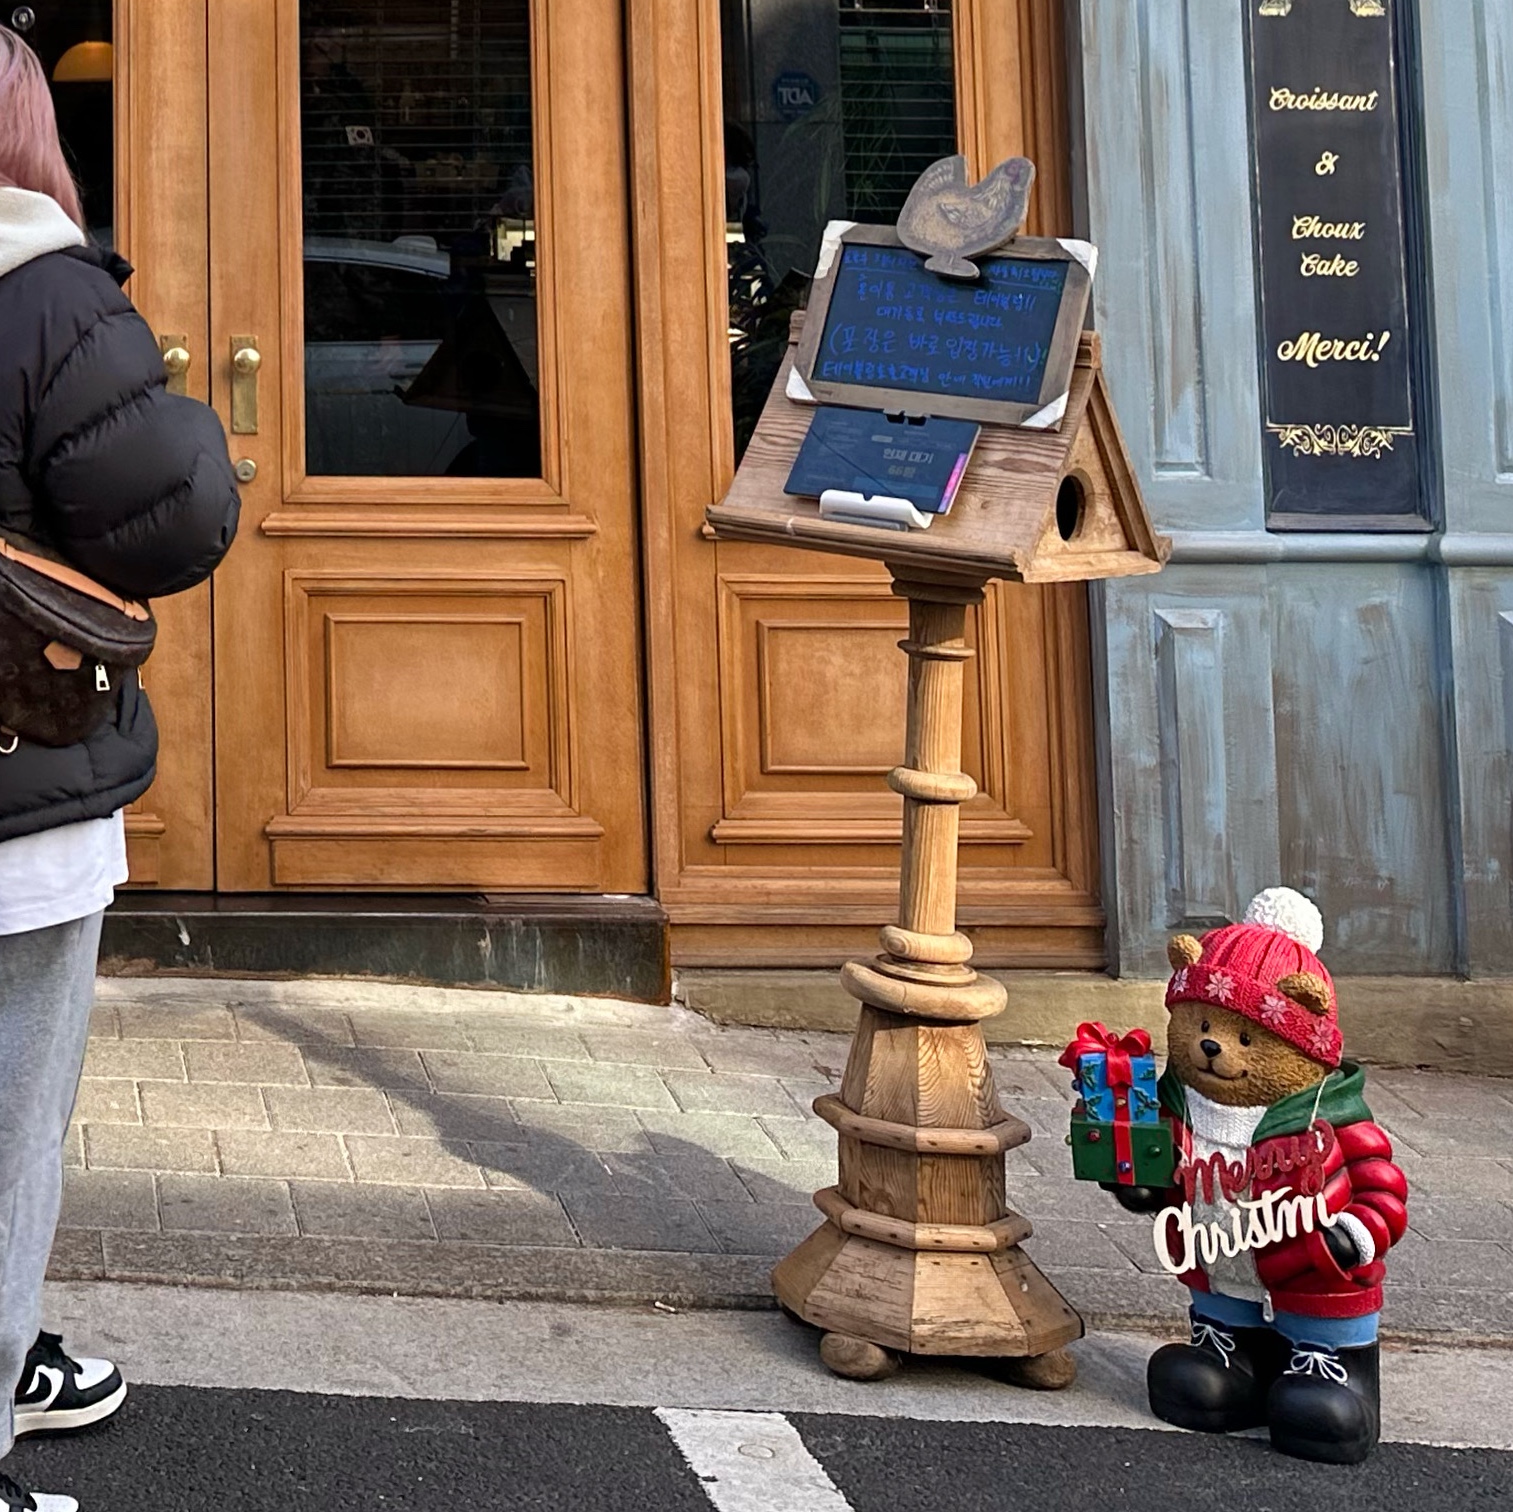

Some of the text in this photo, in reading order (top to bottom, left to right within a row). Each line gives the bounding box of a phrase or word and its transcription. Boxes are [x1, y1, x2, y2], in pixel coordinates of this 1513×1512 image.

[1269, 86, 1378, 112] Croissant
[1315, 151, 1339, 175] &
[1292, 215, 1365, 240] Choux
[1300, 253, 1360, 278] Cake
[908, 332, 940, 356] 바로
[1277, 330, 1390, 368] Merci!
[1174, 1119, 1335, 1205] Merry
